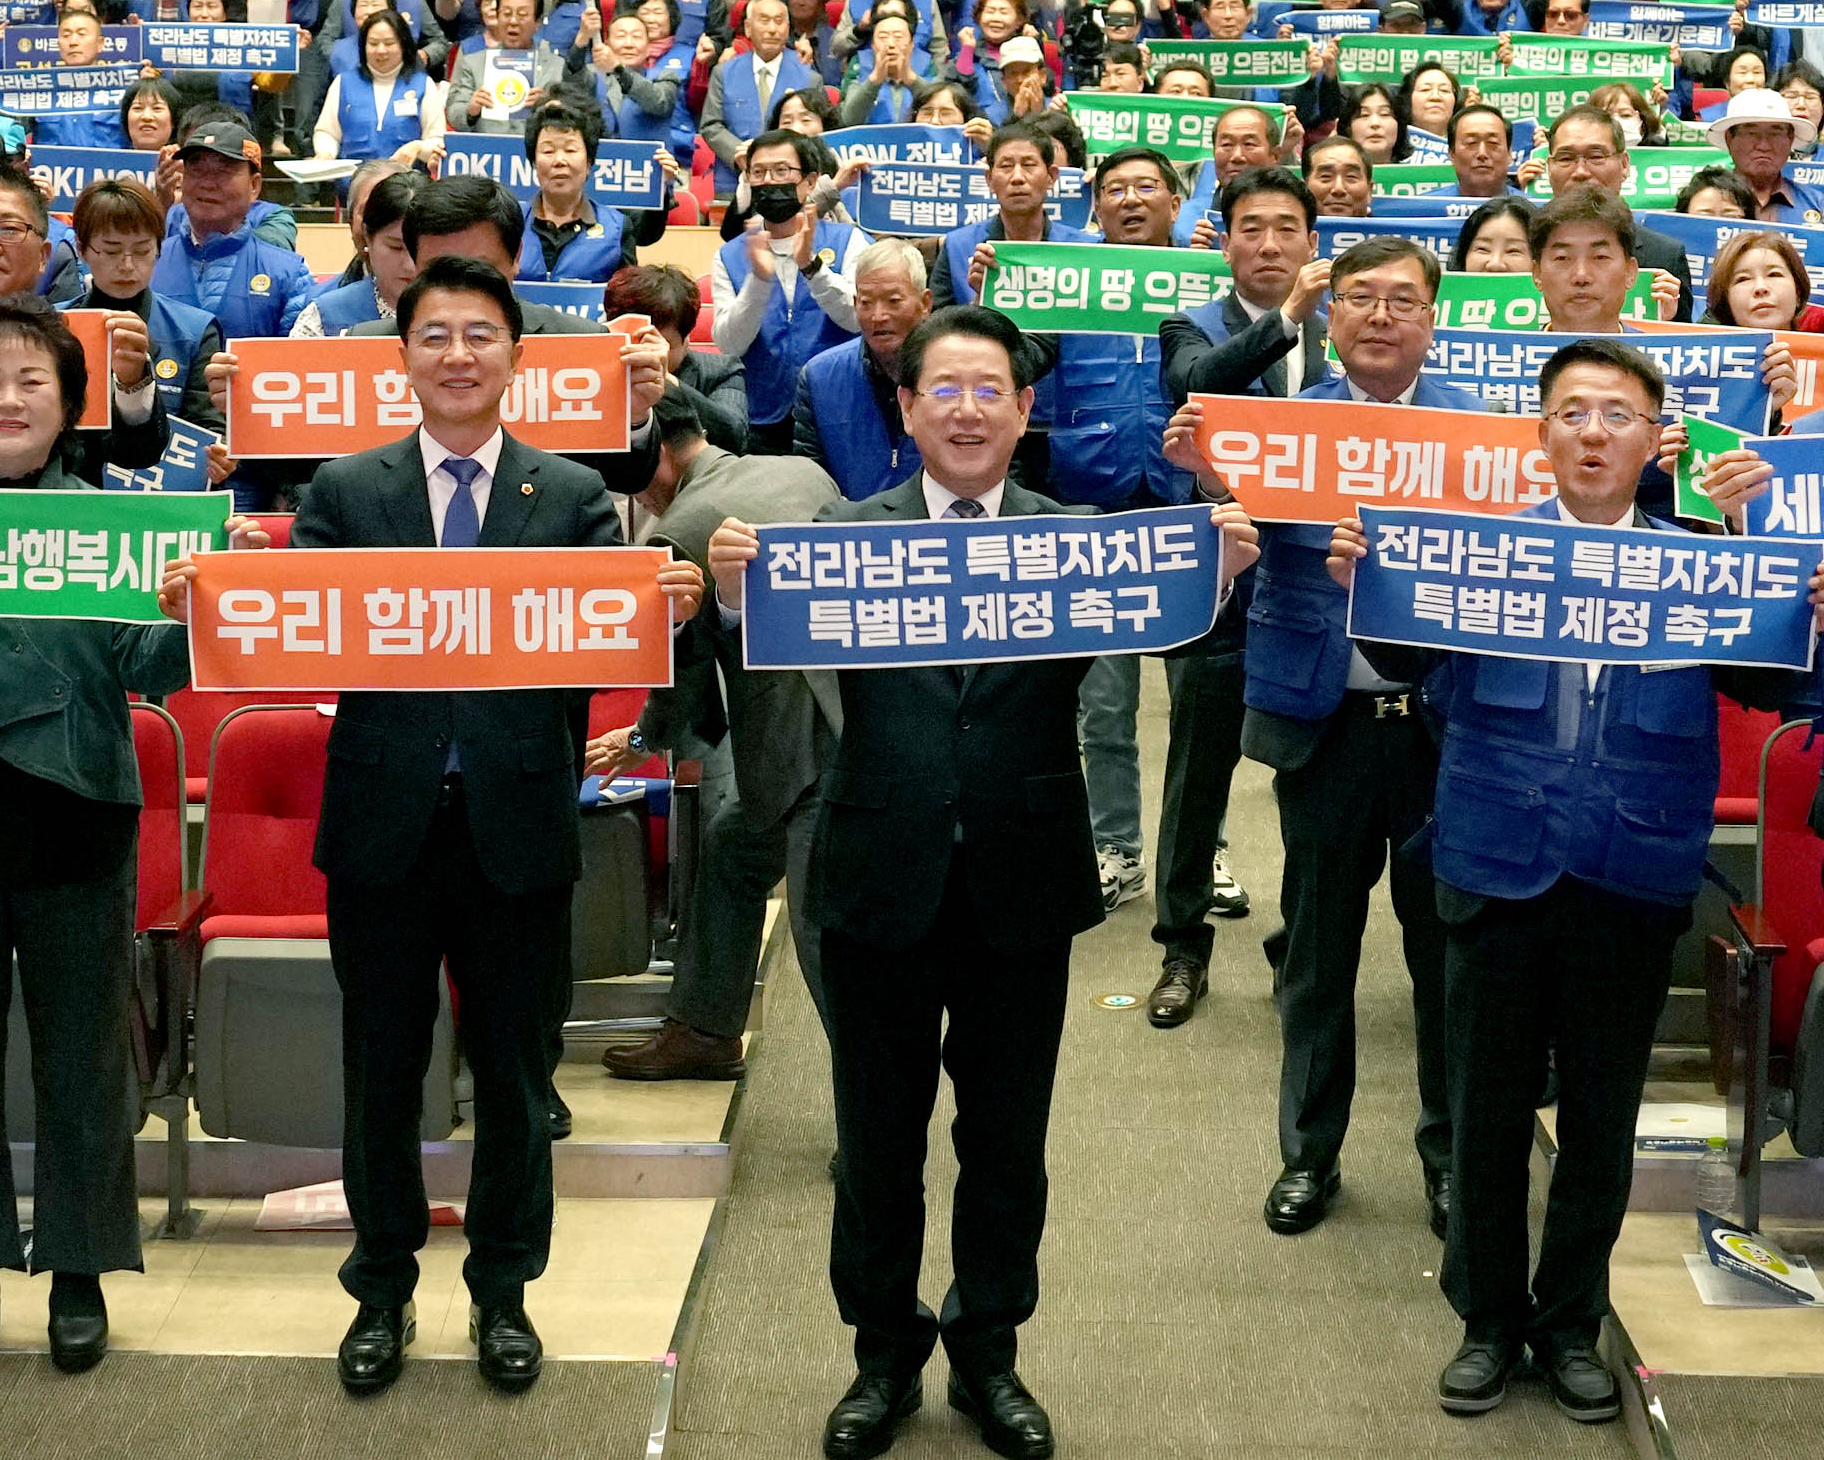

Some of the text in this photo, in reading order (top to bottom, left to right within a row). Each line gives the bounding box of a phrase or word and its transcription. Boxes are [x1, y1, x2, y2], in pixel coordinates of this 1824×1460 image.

[148, 28, 290, 47] 전라남도 특별자치도
[1586, 21, 1722, 47] 바르게살기운동!
[1629, 6, 1686, 22] 함께하는
[161, 47, 277, 66] 특별법 제정 촉구
[1510, 44, 1666, 78] 생명의 땅 으뜸전남
[448, 152, 653, 193] OK! 전남
[994, 266, 1090, 309] 생명의
[1100, 269, 1135, 311] 땅
[251, 370, 355, 427] 우리
[373, 369, 423, 426] 함
[1210, 431, 1317, 492] 우리
[1335, 436, 1446, 499] 함께
[768, 538, 952, 590] 전라남도
[966, 524, 1198, 581] 특별자치도
[1376, 525, 1799, 599] 전라남도 특별자치도
[217, 587, 639, 655] 우리 함께 해요
[809, 596, 947, 648] 특별법
[961, 585, 1161, 641] 제정 촉구
[1413, 582, 1753, 647] 특별법 제정 촉구
